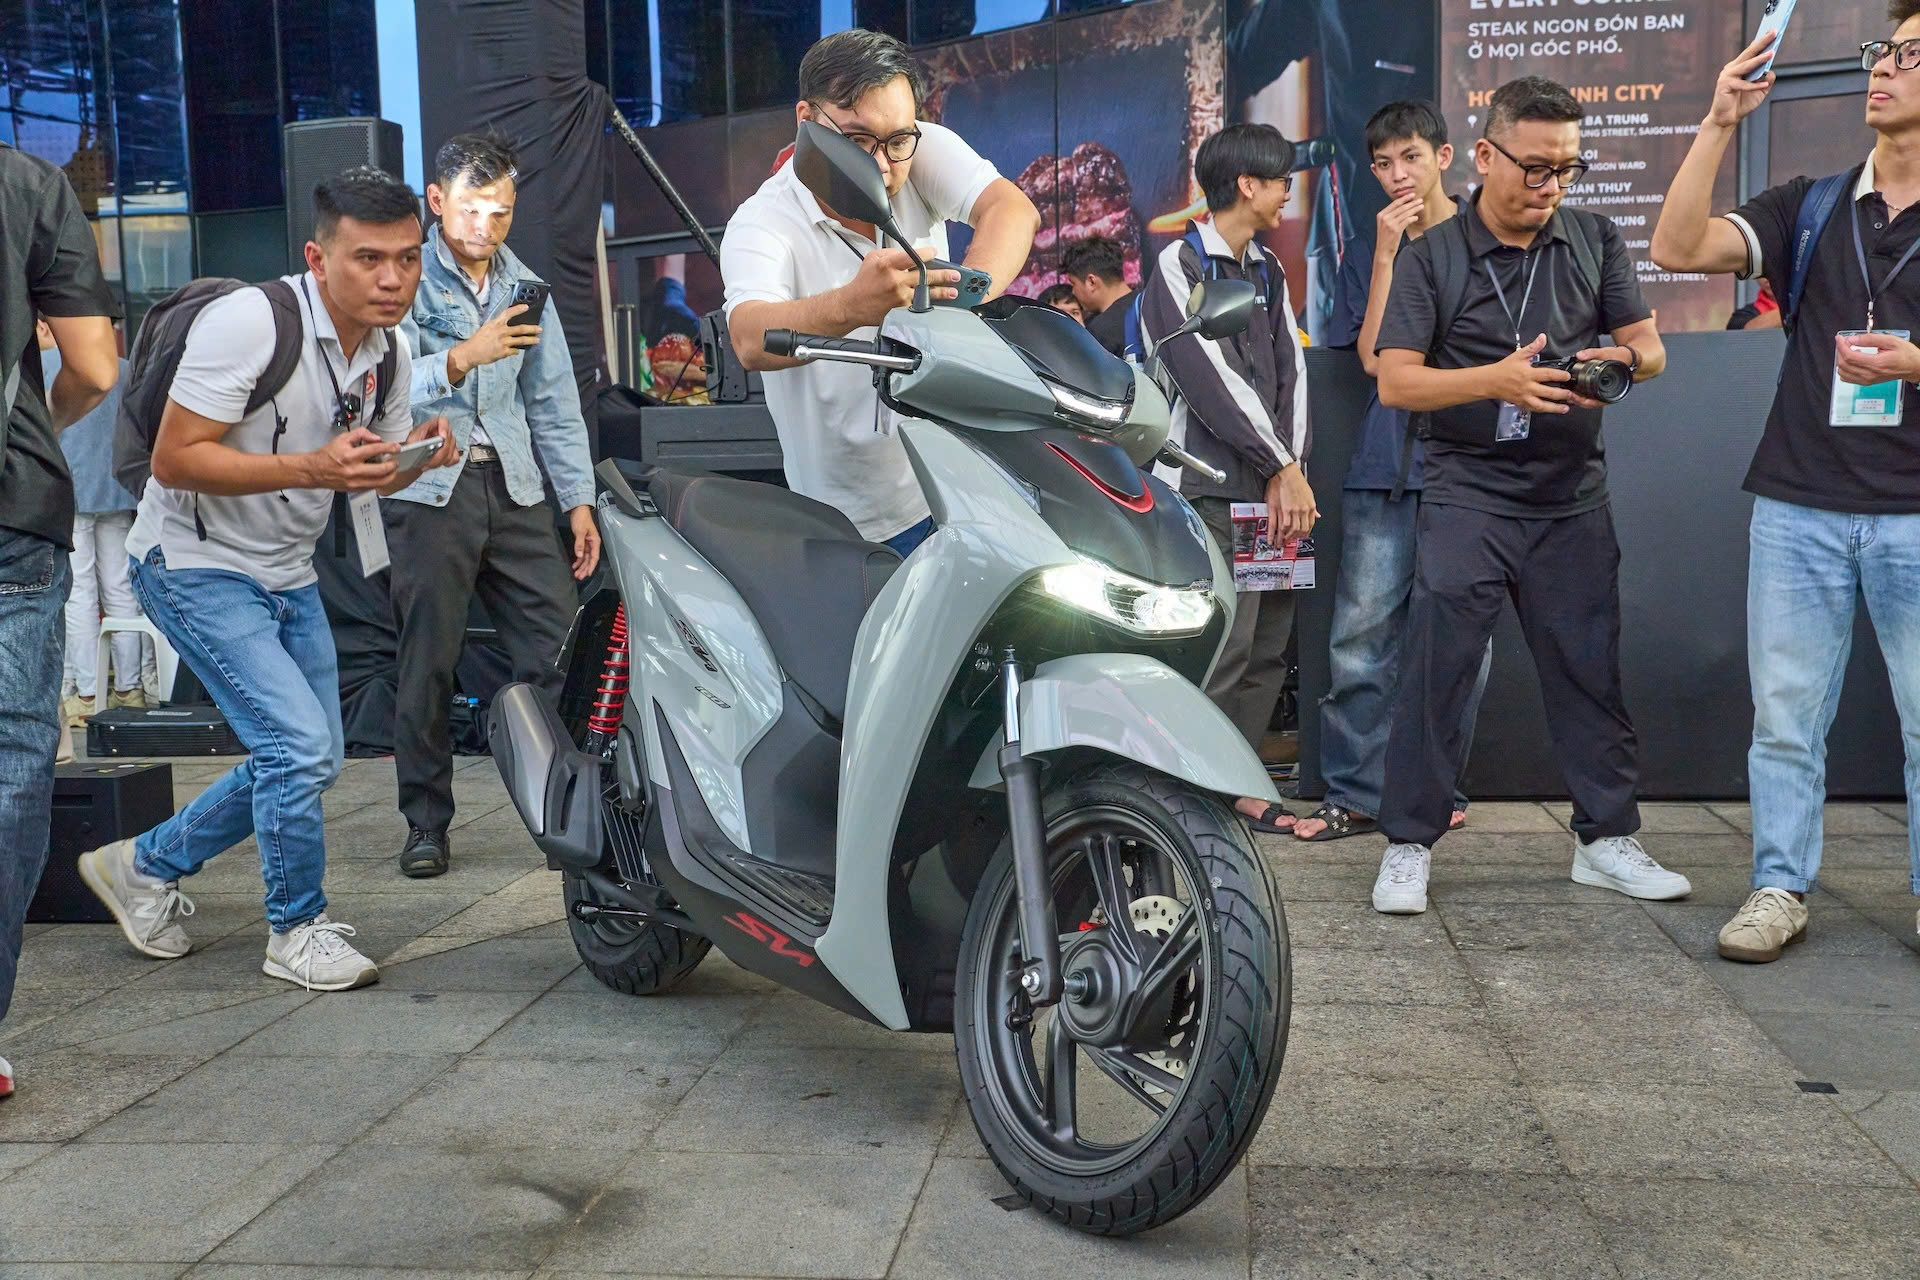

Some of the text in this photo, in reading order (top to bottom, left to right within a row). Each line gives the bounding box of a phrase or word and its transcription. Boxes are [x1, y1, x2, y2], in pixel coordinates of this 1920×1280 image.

[1468, 14, 1685, 37] STEAK NGON ĐÓN BẠN
[1468, 35, 1623, 60] Ở MỌI GÓC PHỐ.
[1615, 84, 1664, 102] CITY
[1585, 115, 1603, 126] BA
[1606, 113, 1649, 125] TRUNG
[1601, 127, 1637, 137] STREET,
[1639, 126, 1673, 136] SAIGON
[1618, 161, 1647, 170] WARD
[1598, 182, 1633, 193] THUY
[1587, 196, 1601, 205] AN
[1602, 195, 1635, 205] KHANH
[1636, 194, 1664, 204] WARD
[1657, 273, 1671, 282] TO
[1672, 272, 1709, 282] STREET,
